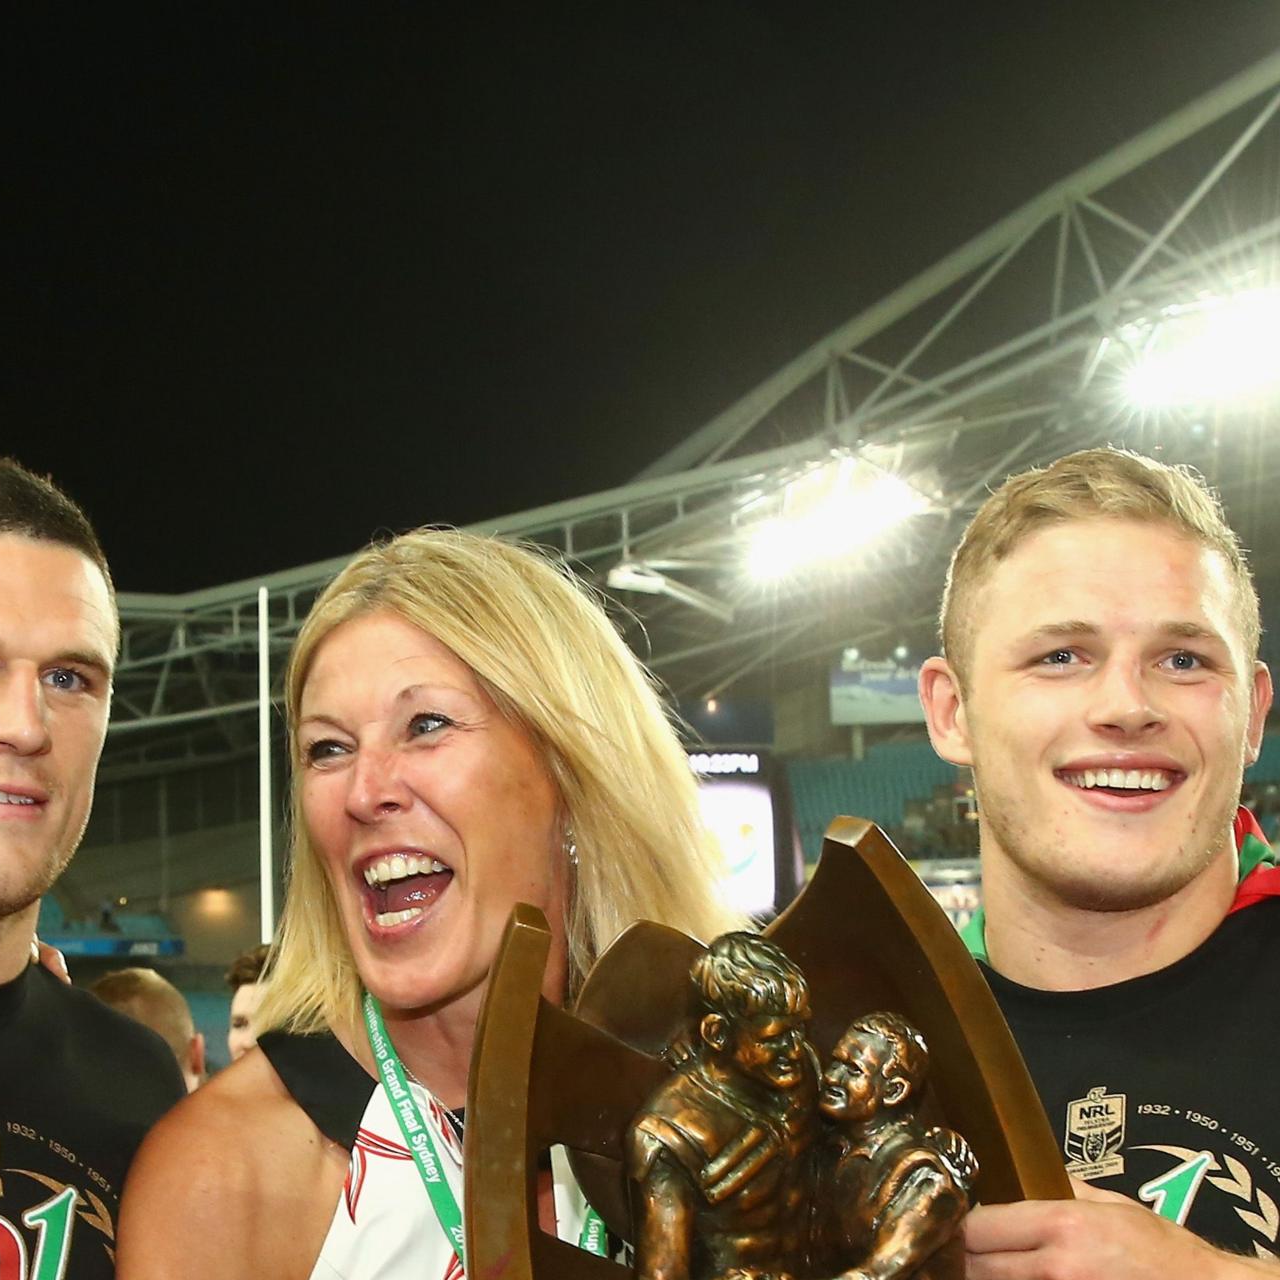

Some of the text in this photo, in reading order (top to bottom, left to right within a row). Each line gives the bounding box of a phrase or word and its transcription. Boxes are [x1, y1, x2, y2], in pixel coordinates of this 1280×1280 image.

[382, 1059, 408, 1100] Grand
[397, 1098, 422, 1133] Final
[411, 1132, 442, 1184] Sydney
[1079, 1104, 1116, 1120] NRL
[1137, 1104, 1171, 1116] 1932
[1185, 1110, 1219, 1131] 1950
[1230, 1132, 1261, 1156] 1951
[6, 1121, 112, 1193] 1932 1950 1951
